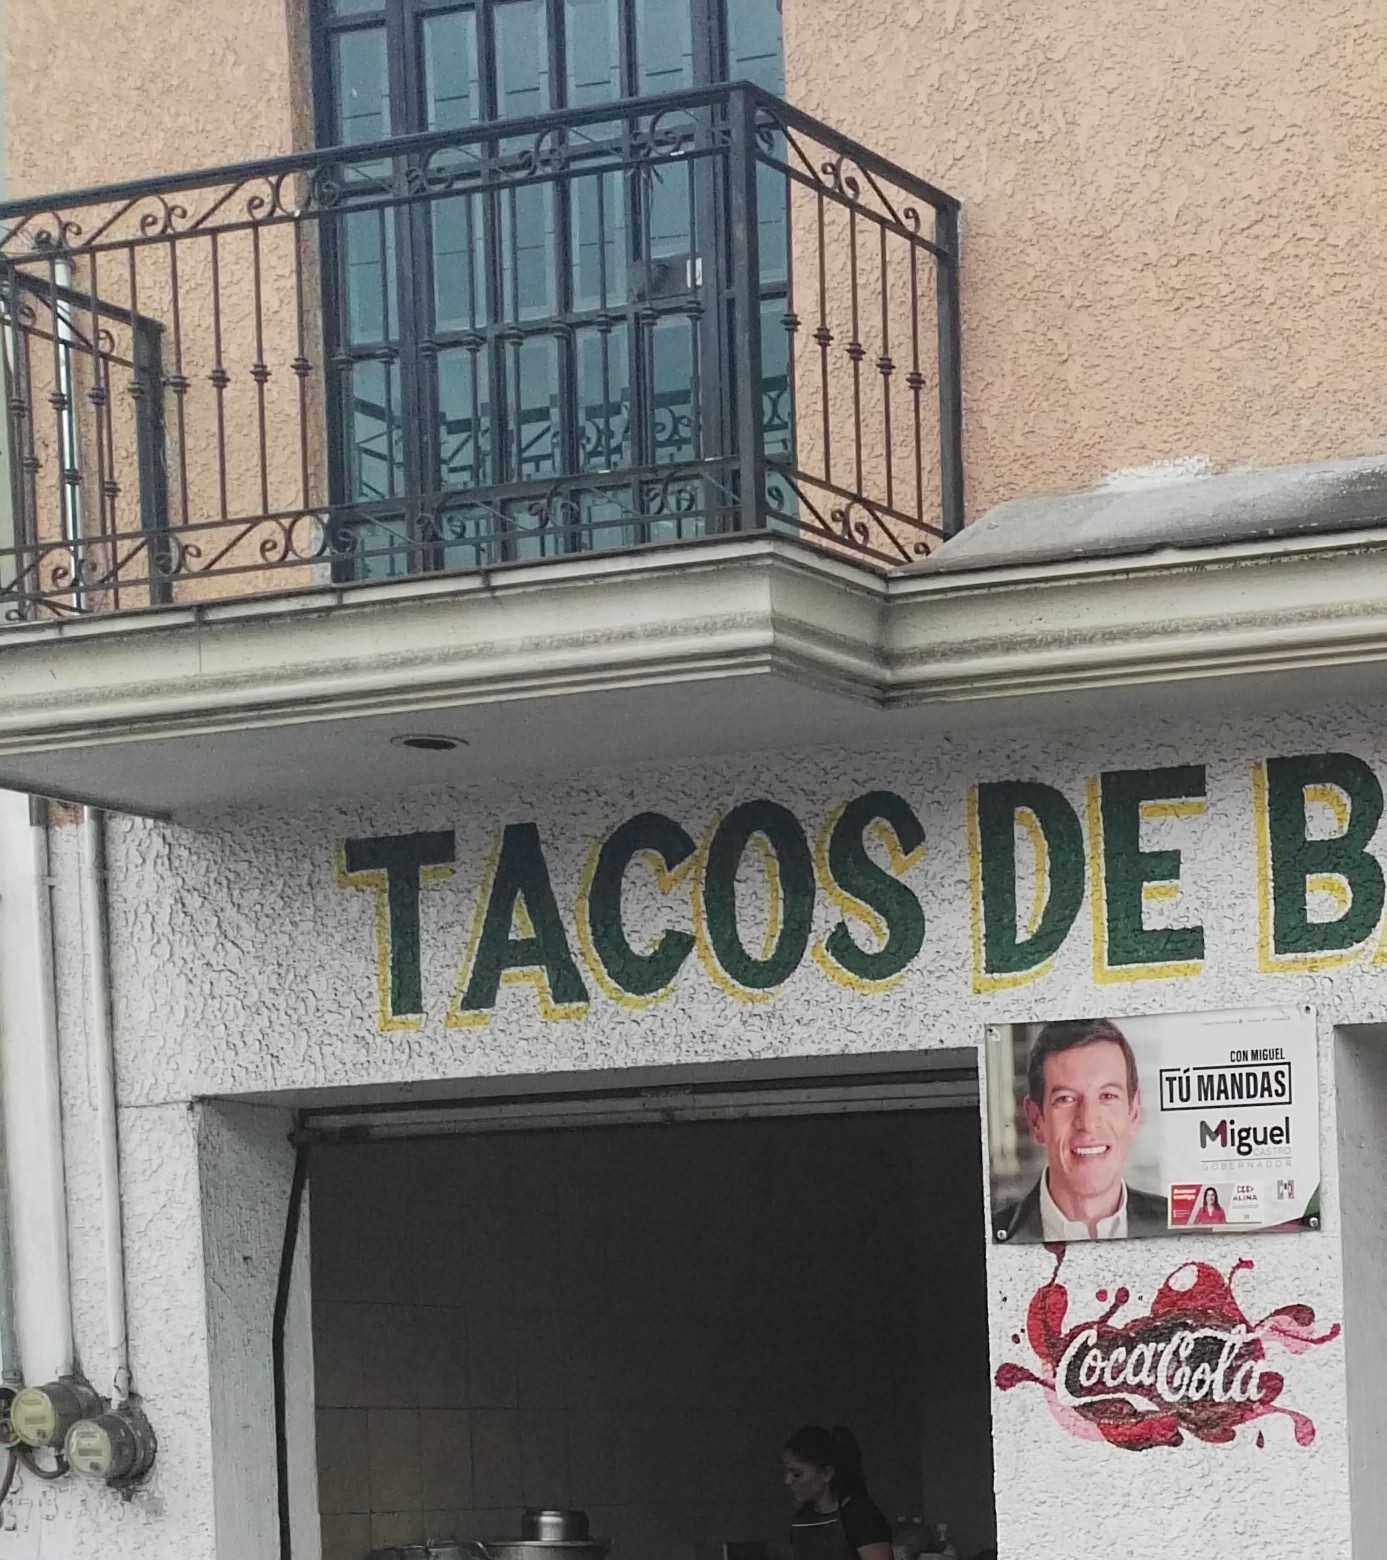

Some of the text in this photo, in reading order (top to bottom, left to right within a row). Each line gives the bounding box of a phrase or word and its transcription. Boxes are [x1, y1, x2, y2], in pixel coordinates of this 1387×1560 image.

[336, 791, 927, 1031] TACOS
[969, 763, 1206, 993] DE
[1230, 1047, 1286, 1063] CON MIGUEL
[1165, 1067, 1287, 1103] TÚ MANDAS
[1199, 1116, 1291, 1156] Miguel
[1254, 1146, 1291, 1157] CASTRO
[1202, 1160, 1292, 1171] GOBERNADOR
[1055, 1322, 1266, 1411] Coca-Cola
